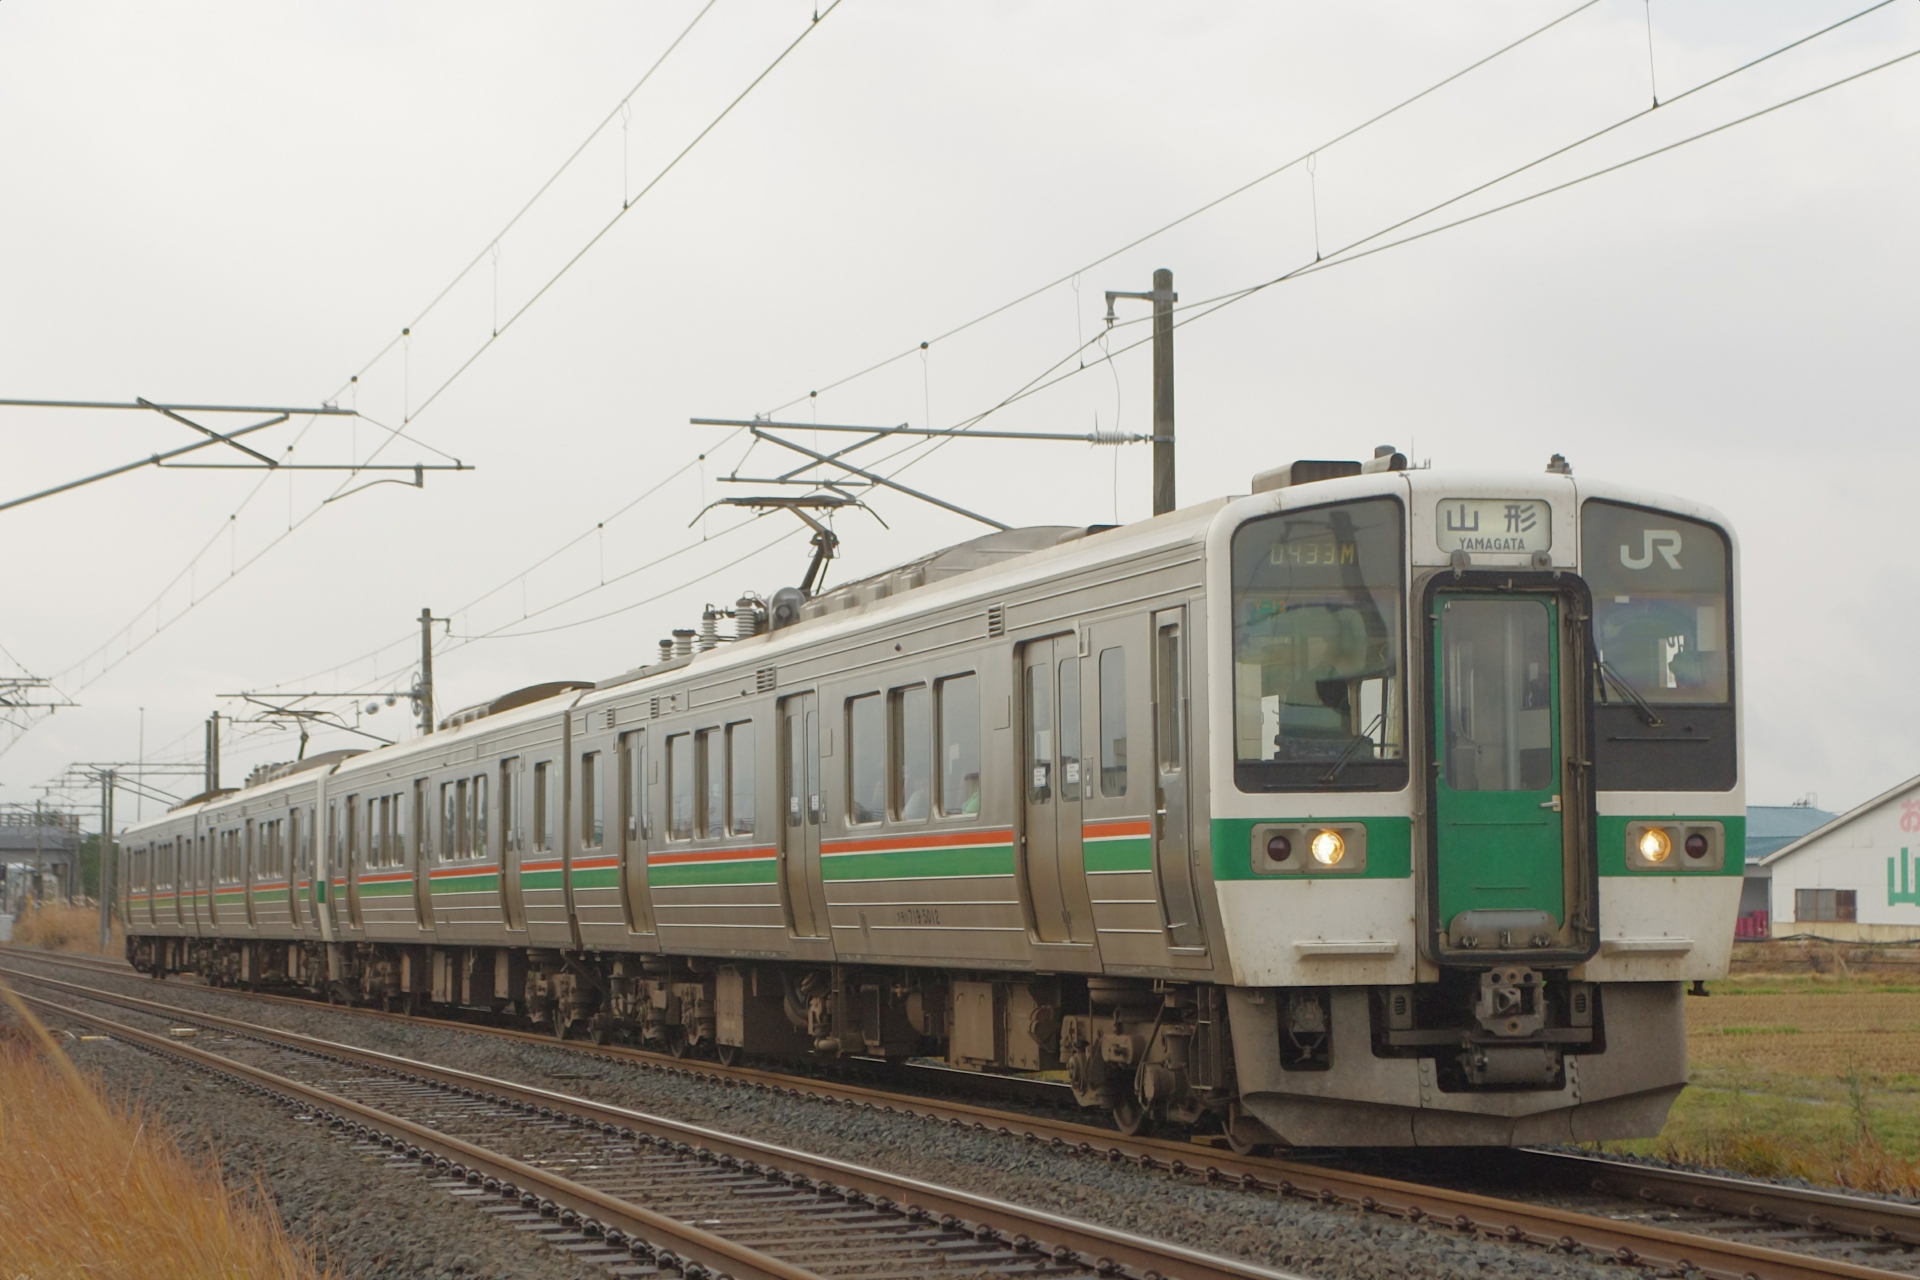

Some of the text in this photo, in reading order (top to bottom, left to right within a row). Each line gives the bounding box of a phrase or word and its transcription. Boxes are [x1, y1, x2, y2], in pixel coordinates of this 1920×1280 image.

[1447, 503, 1537, 533] 山形
[1459, 537, 1525, 550] YAMAGATA
[1620, 529, 1682, 569] JR
